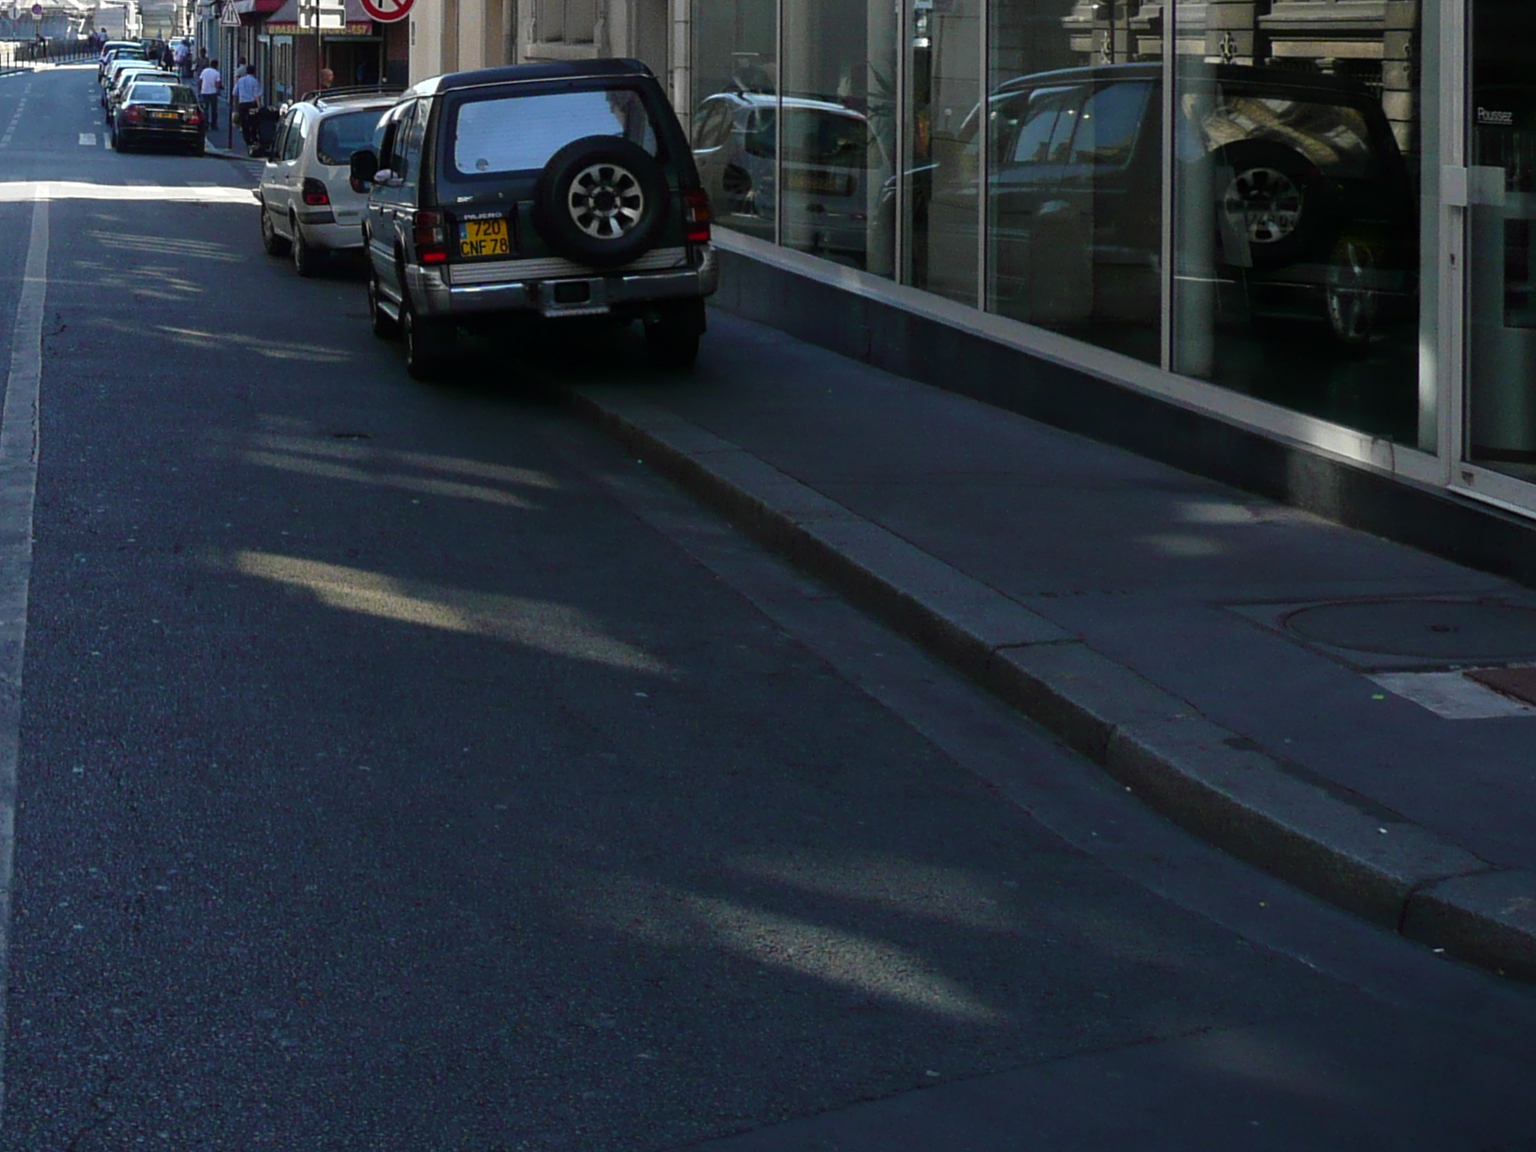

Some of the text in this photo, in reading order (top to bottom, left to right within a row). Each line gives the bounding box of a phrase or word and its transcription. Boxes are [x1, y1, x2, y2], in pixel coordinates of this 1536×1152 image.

[1477, 106, 1513, 122] Poussez
[473, 220, 501, 237] 720
[460, 237, 508, 256] CNF 78
